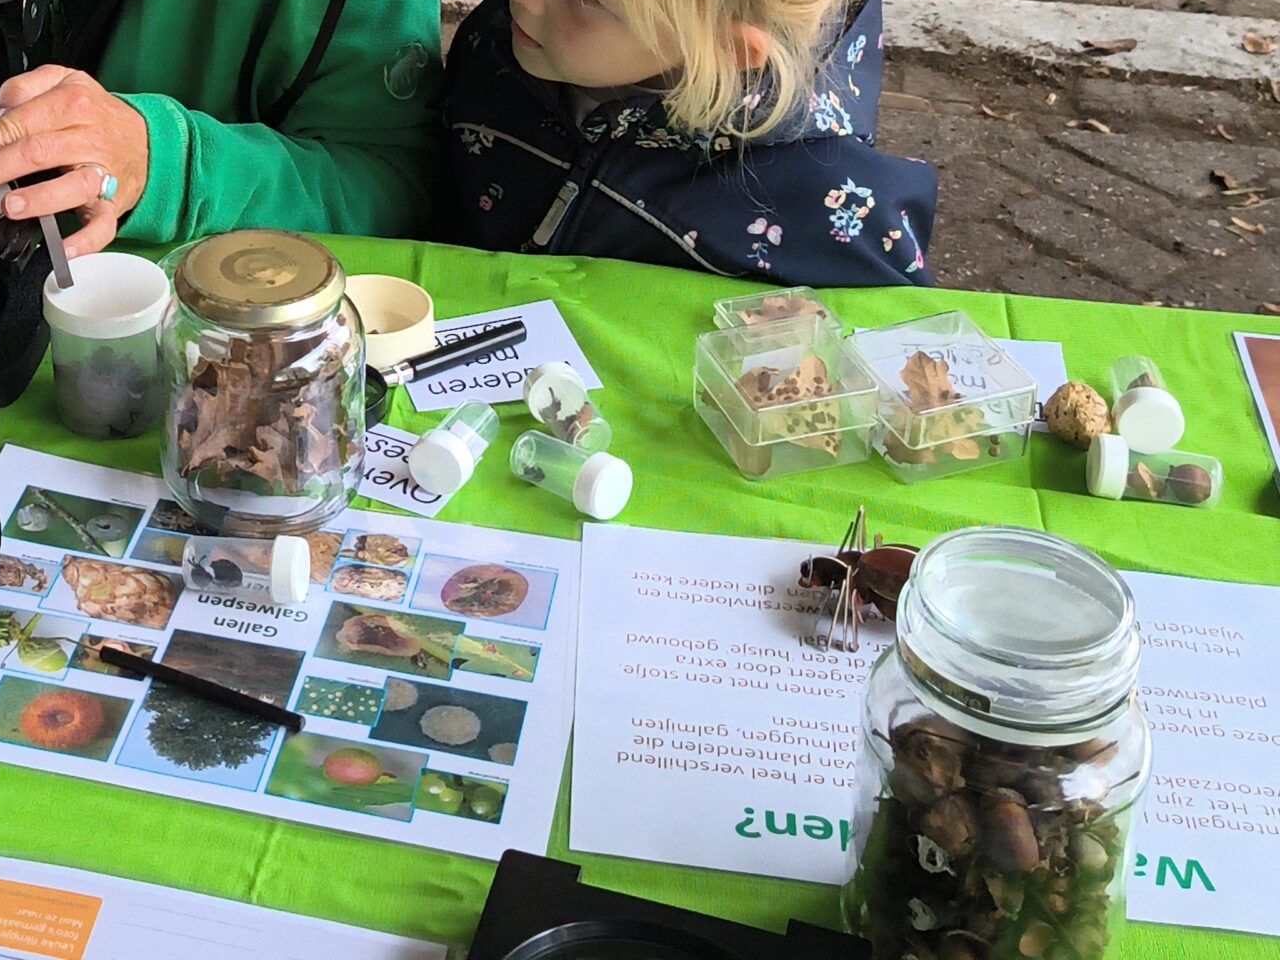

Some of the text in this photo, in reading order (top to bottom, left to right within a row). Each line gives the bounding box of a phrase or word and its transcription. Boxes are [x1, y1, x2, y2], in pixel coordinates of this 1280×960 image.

[631, 571, 672, 586] keer
[679, 575, 740, 592] iedere
[745, 584, 775, 597] die
[197, 593, 309, 623] Galwespen
[637, 586, 819, 616] weersinvloeden en
[213, 616, 278, 638] Gallen
[625, 632, 719, 653] gebouwd
[1203, 643, 1241, 658] Het
[675, 654, 727, 670] extra
[801, 651, 839, 666] een
[733, 661, 781, 677] door
[685, 671, 723, 687] een
[731, 677, 769, 693] met
[775, 682, 845, 700] samen
[1134, 686, 1267, 710] plantenwee
[1155, 704, 1192, 720] het
[1199, 709, 1218, 720] in
[630, 717, 729, 737] galmijten
[632, 735, 856, 770] van plantendelen die
[615, 751, 745, 776] verschillend
[751, 767, 796, 785] heel
[804, 773, 825, 785] er
[1156, 792, 1194, 809] zijn
[1207, 798, 1248, 815] Het
[40, 937, 74, 953] Leuke
